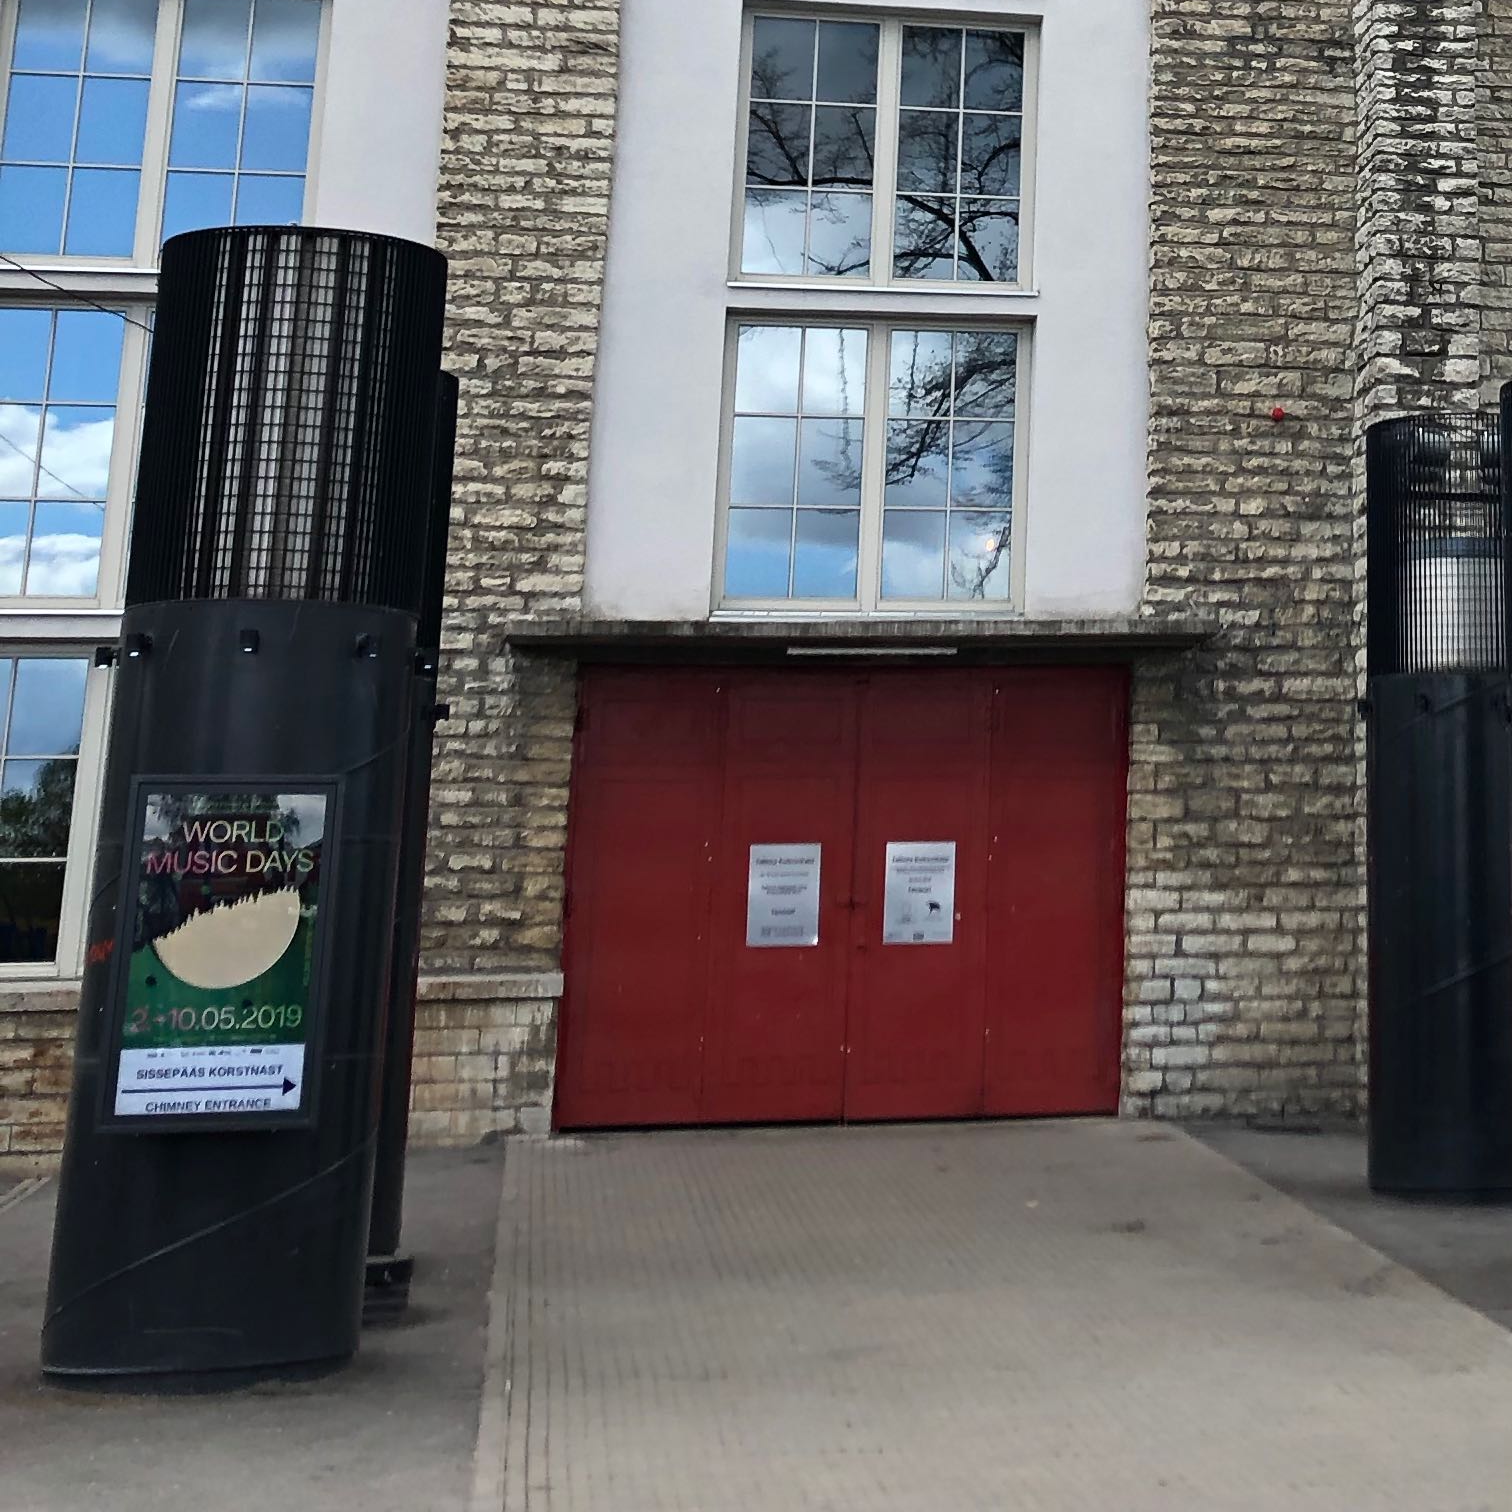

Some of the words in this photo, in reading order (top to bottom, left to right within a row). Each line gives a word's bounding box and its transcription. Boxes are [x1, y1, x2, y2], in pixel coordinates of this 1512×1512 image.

[183, 819, 284, 843] WORLD
[146, 850, 237, 875] MUSIC
[245, 849, 314, 873] DAYS
[136, 1065, 205, 1080] SISSEPÄÄS
[209, 1064, 284, 1078] KORSTNAST
[145, 1100, 201, 1113] CHIMNEY
[205, 1098, 271, 1111] ENTRANCE
